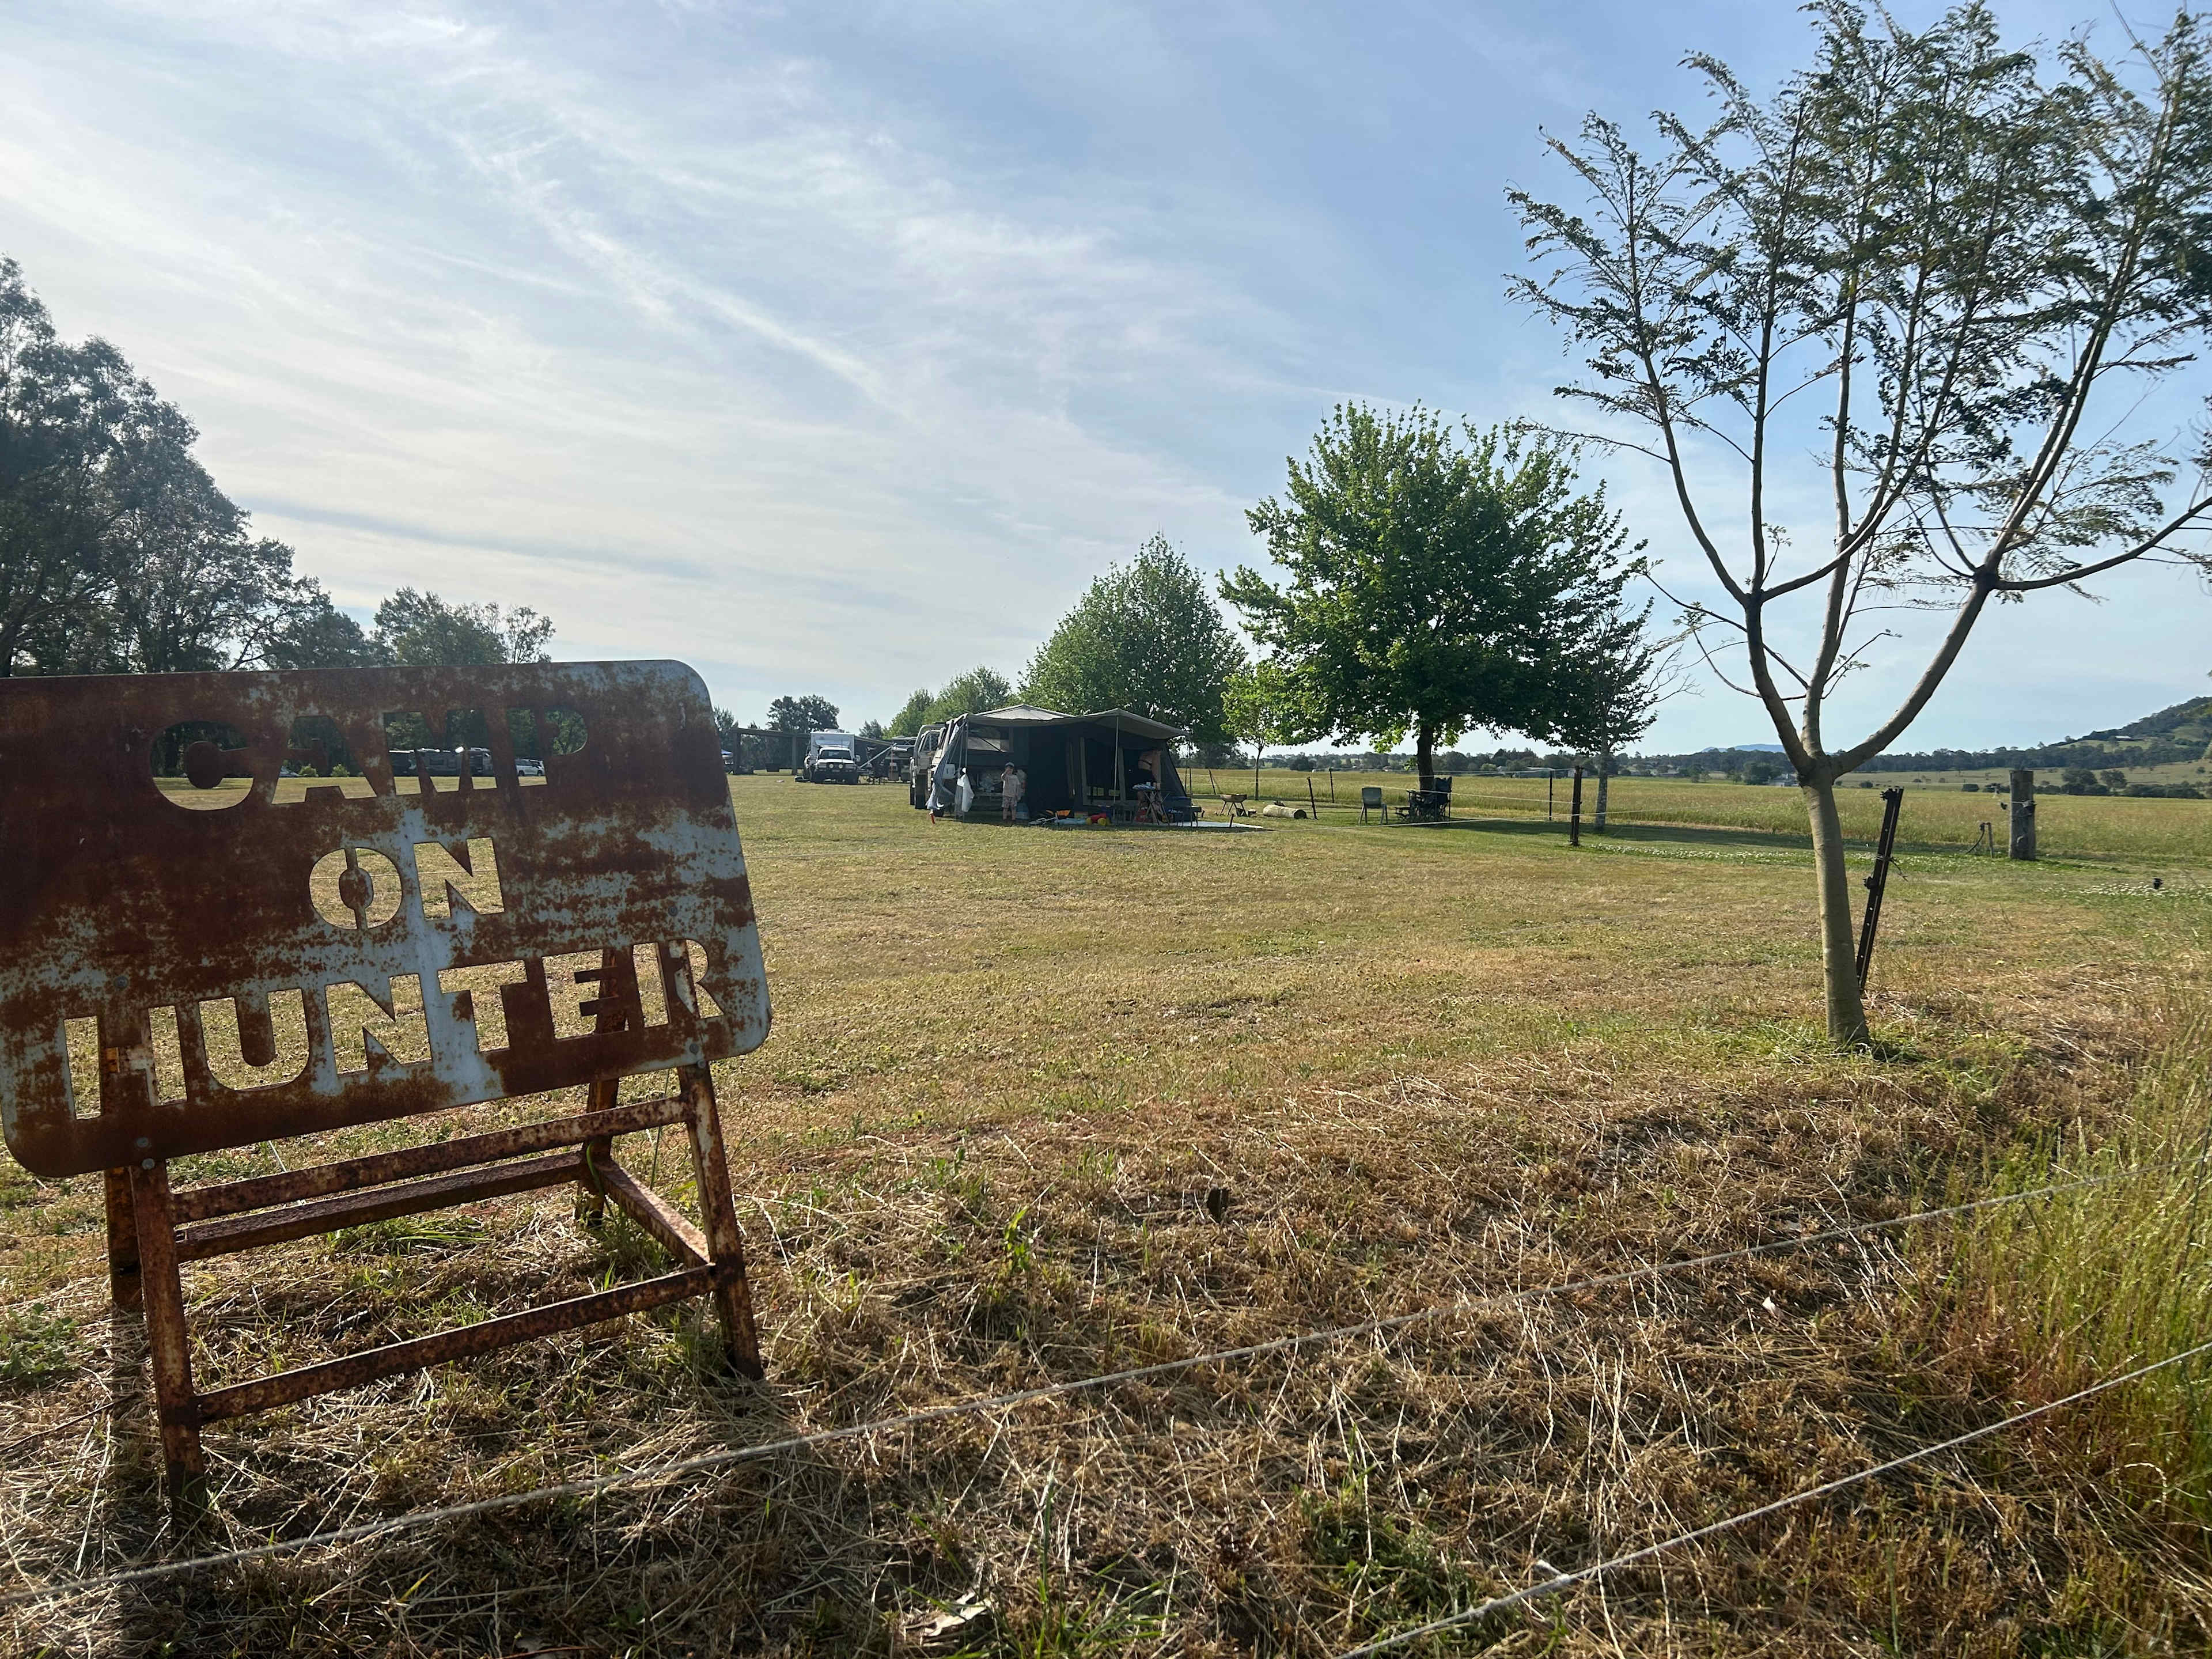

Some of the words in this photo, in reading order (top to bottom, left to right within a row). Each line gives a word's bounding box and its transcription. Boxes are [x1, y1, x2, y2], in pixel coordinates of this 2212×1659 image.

[149, 708, 588, 812] CAMP
[308, 836, 506, 930] ON
[63, 938, 725, 1121] HUNTER
